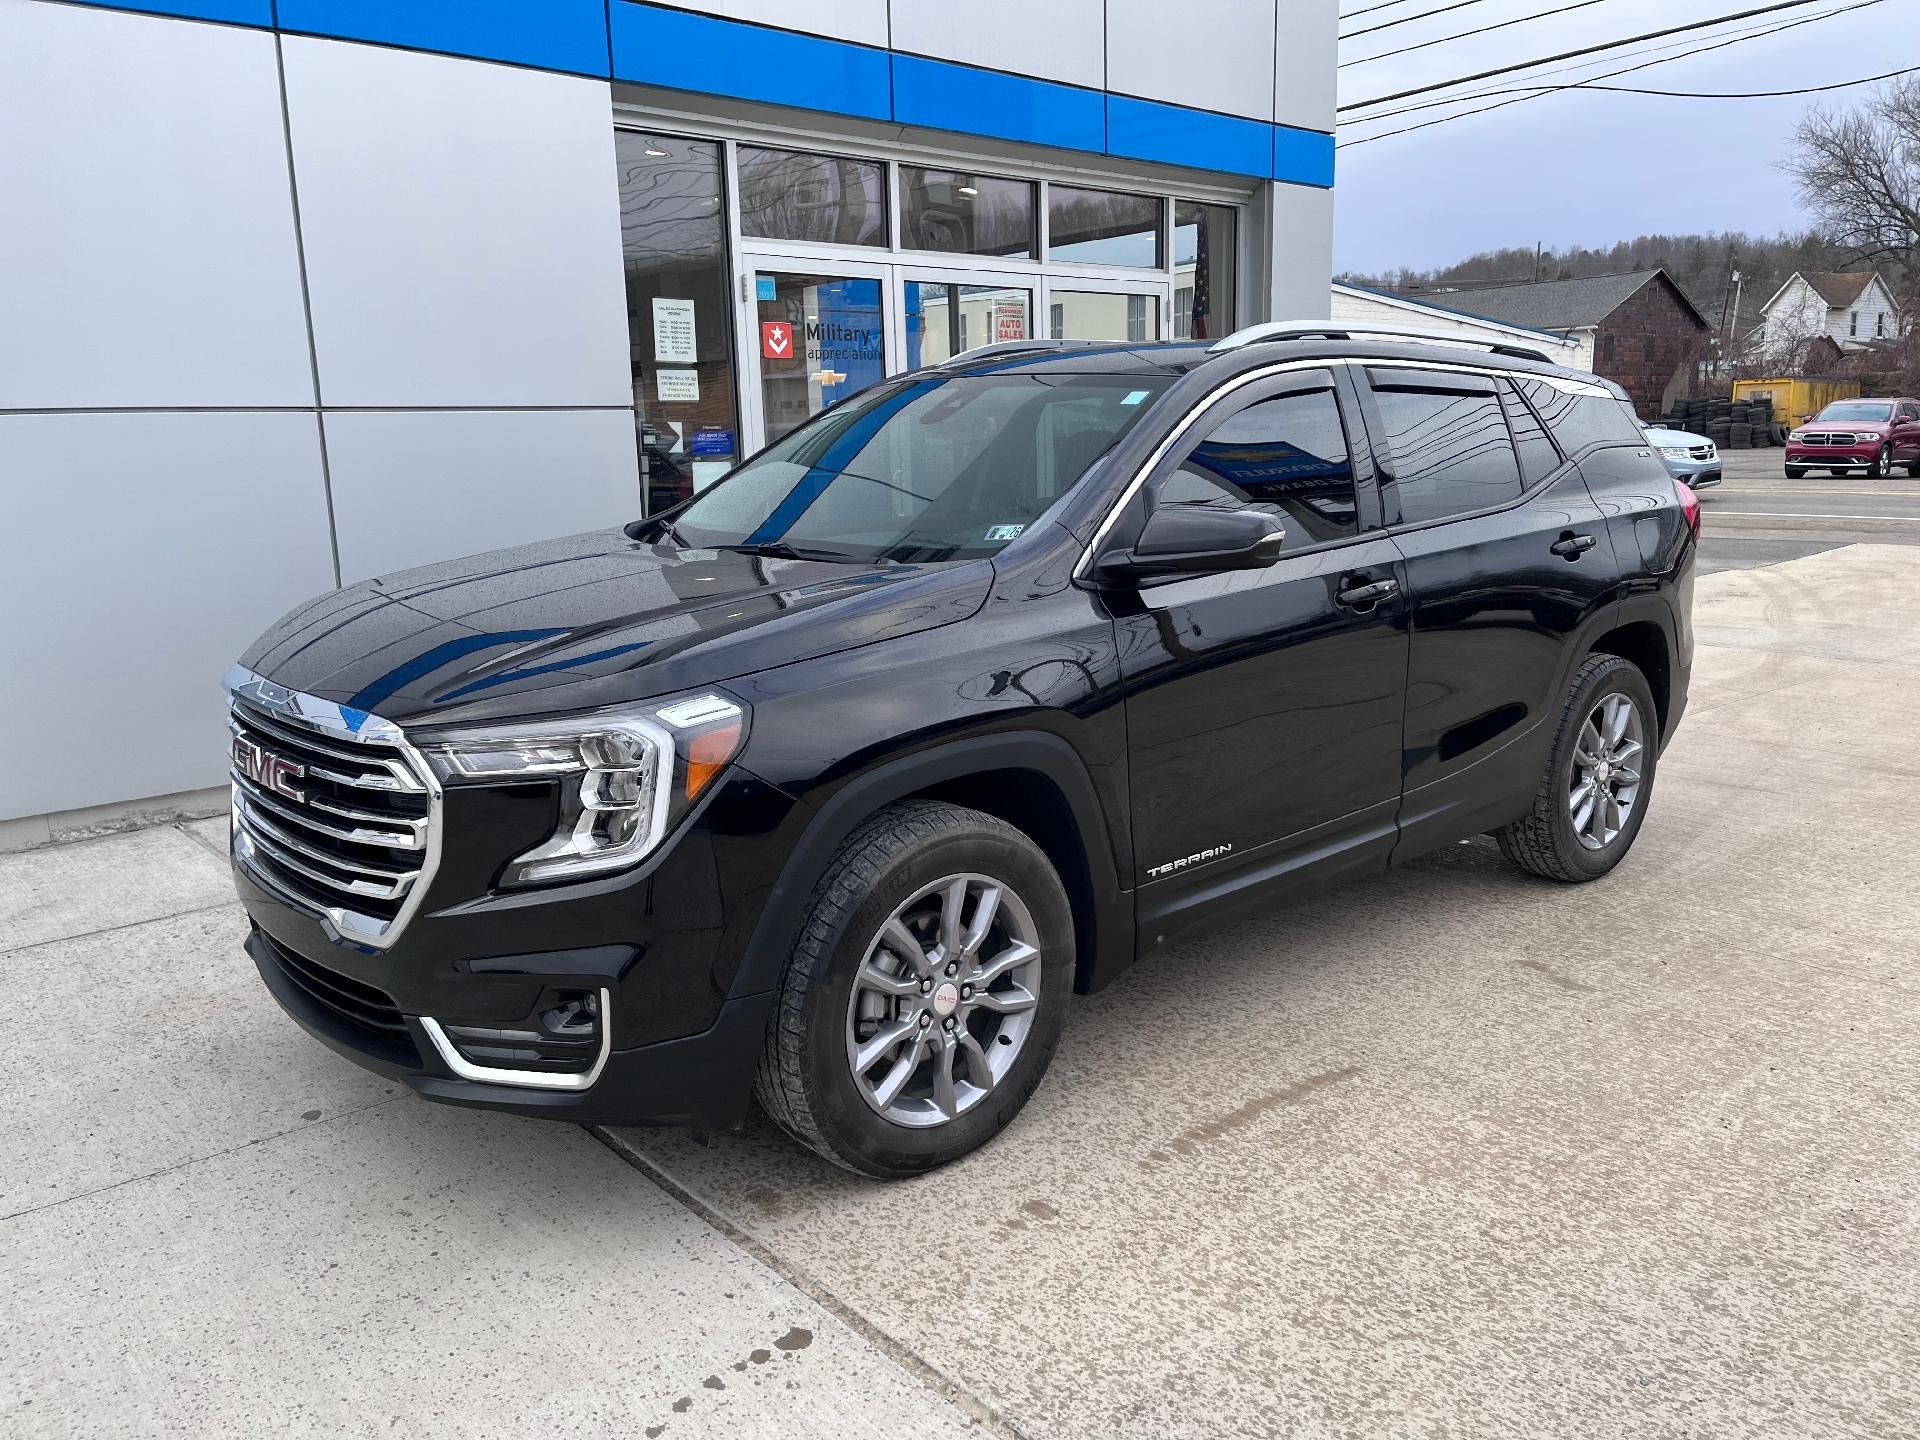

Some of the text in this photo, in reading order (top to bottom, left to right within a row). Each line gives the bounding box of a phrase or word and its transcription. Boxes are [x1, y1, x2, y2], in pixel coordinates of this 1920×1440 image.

[1000, 320, 1020, 328] AUTO
[806, 323, 870, 347] Military
[998, 330, 1024, 340] SALES
[808, 348, 883, 362] appreciation
[232, 736, 305, 803] GMC
[1146, 843, 1232, 877] TERRAIN
